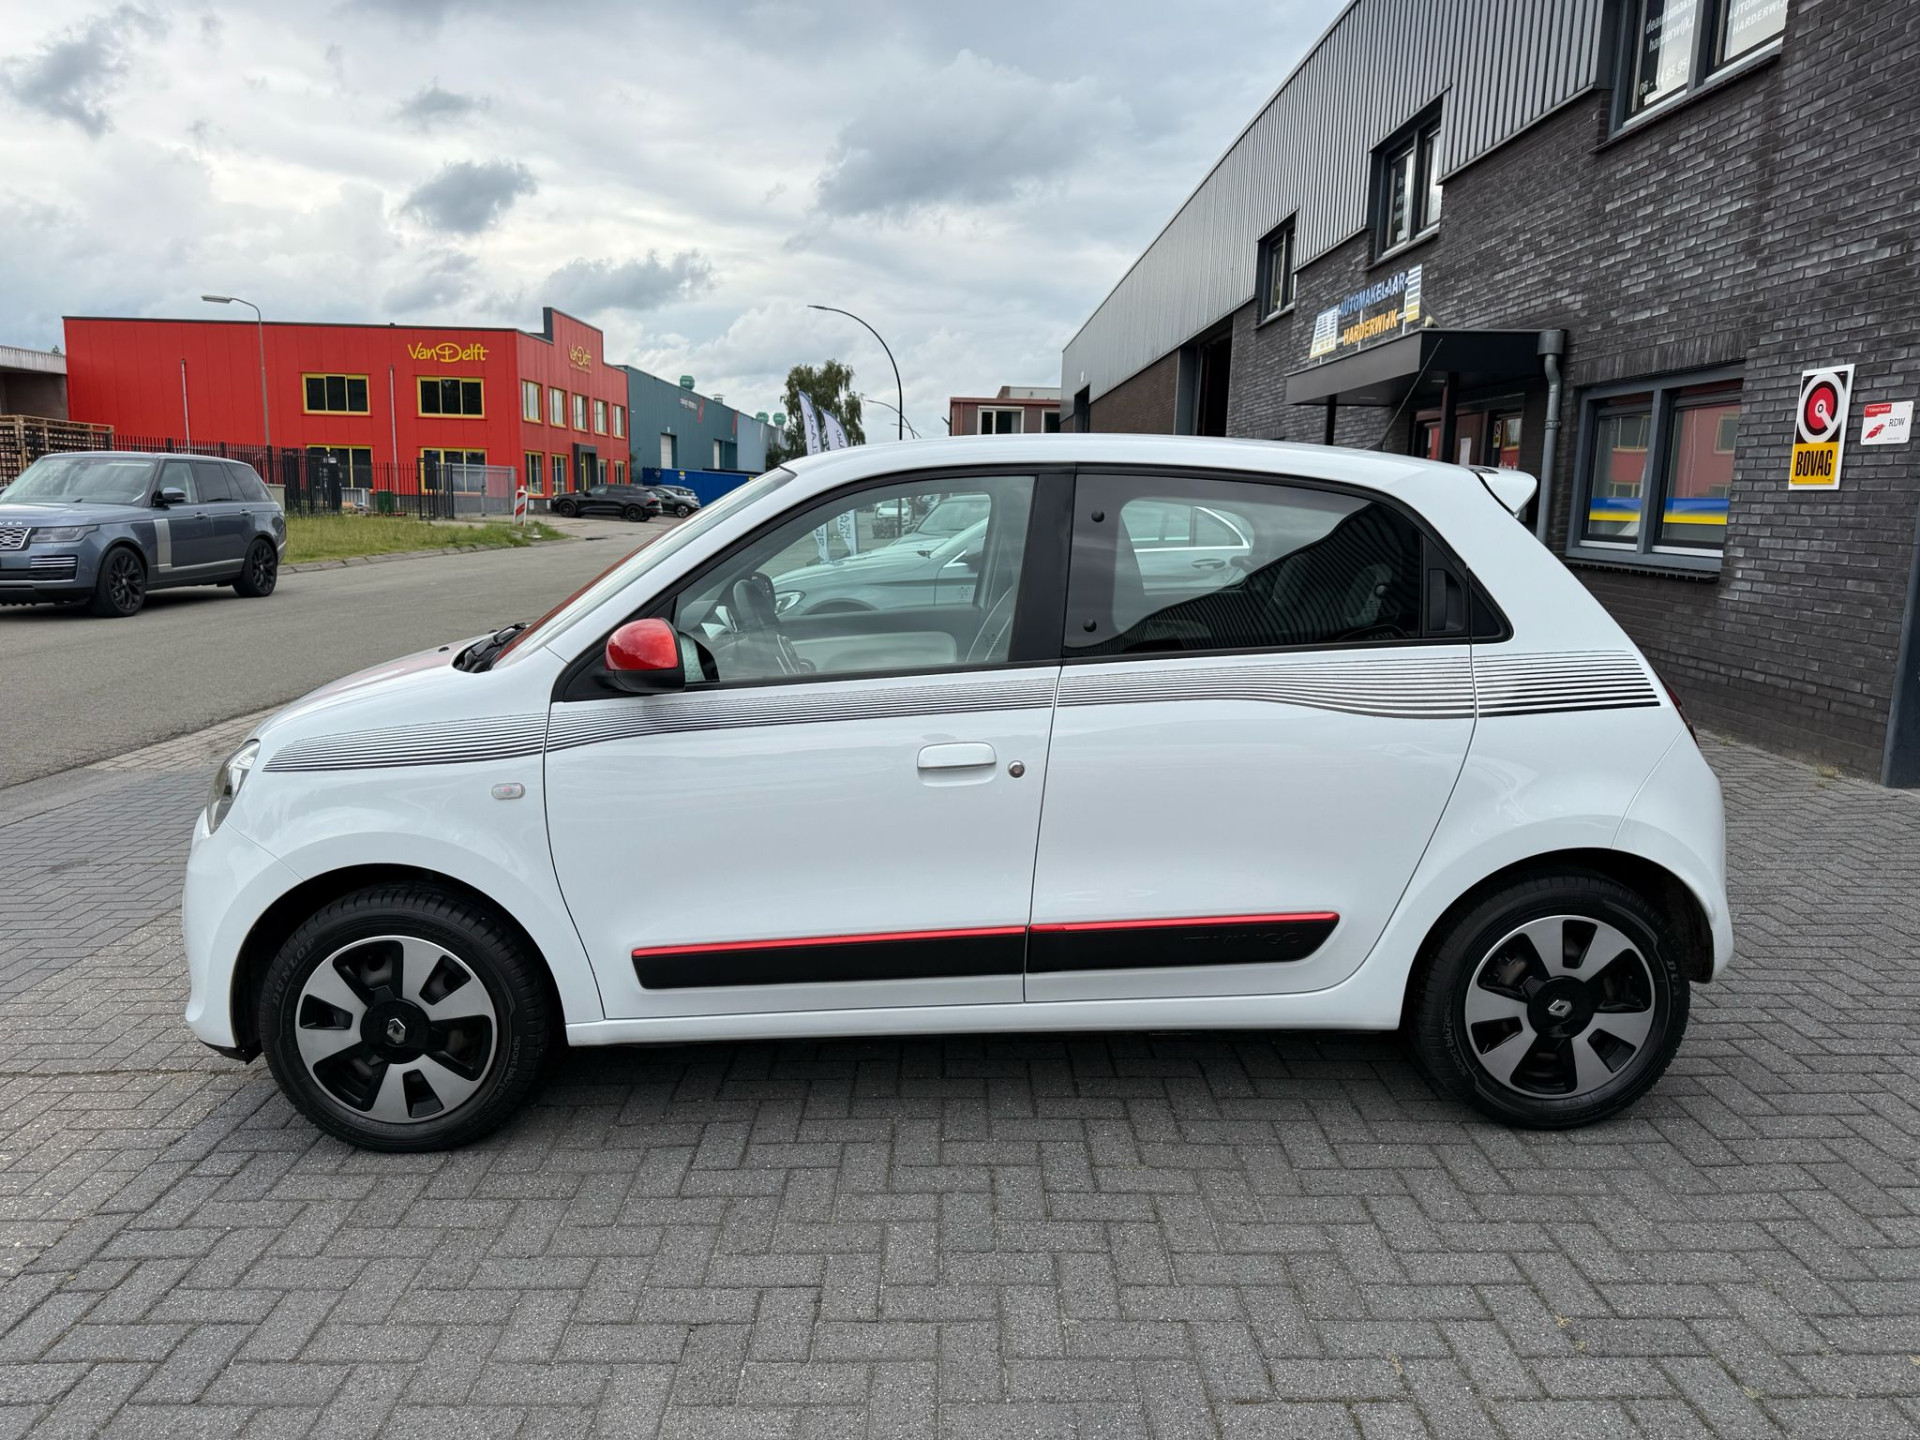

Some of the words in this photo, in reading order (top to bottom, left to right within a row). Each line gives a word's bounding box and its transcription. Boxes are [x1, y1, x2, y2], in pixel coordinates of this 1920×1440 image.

[1343, 308, 1398, 347] HARDERWIJK
[1889, 418, 1906, 428] RDW
[1795, 449, 1833, 477] BOVAG
[272, 938, 316, 1008] DUNLOP
